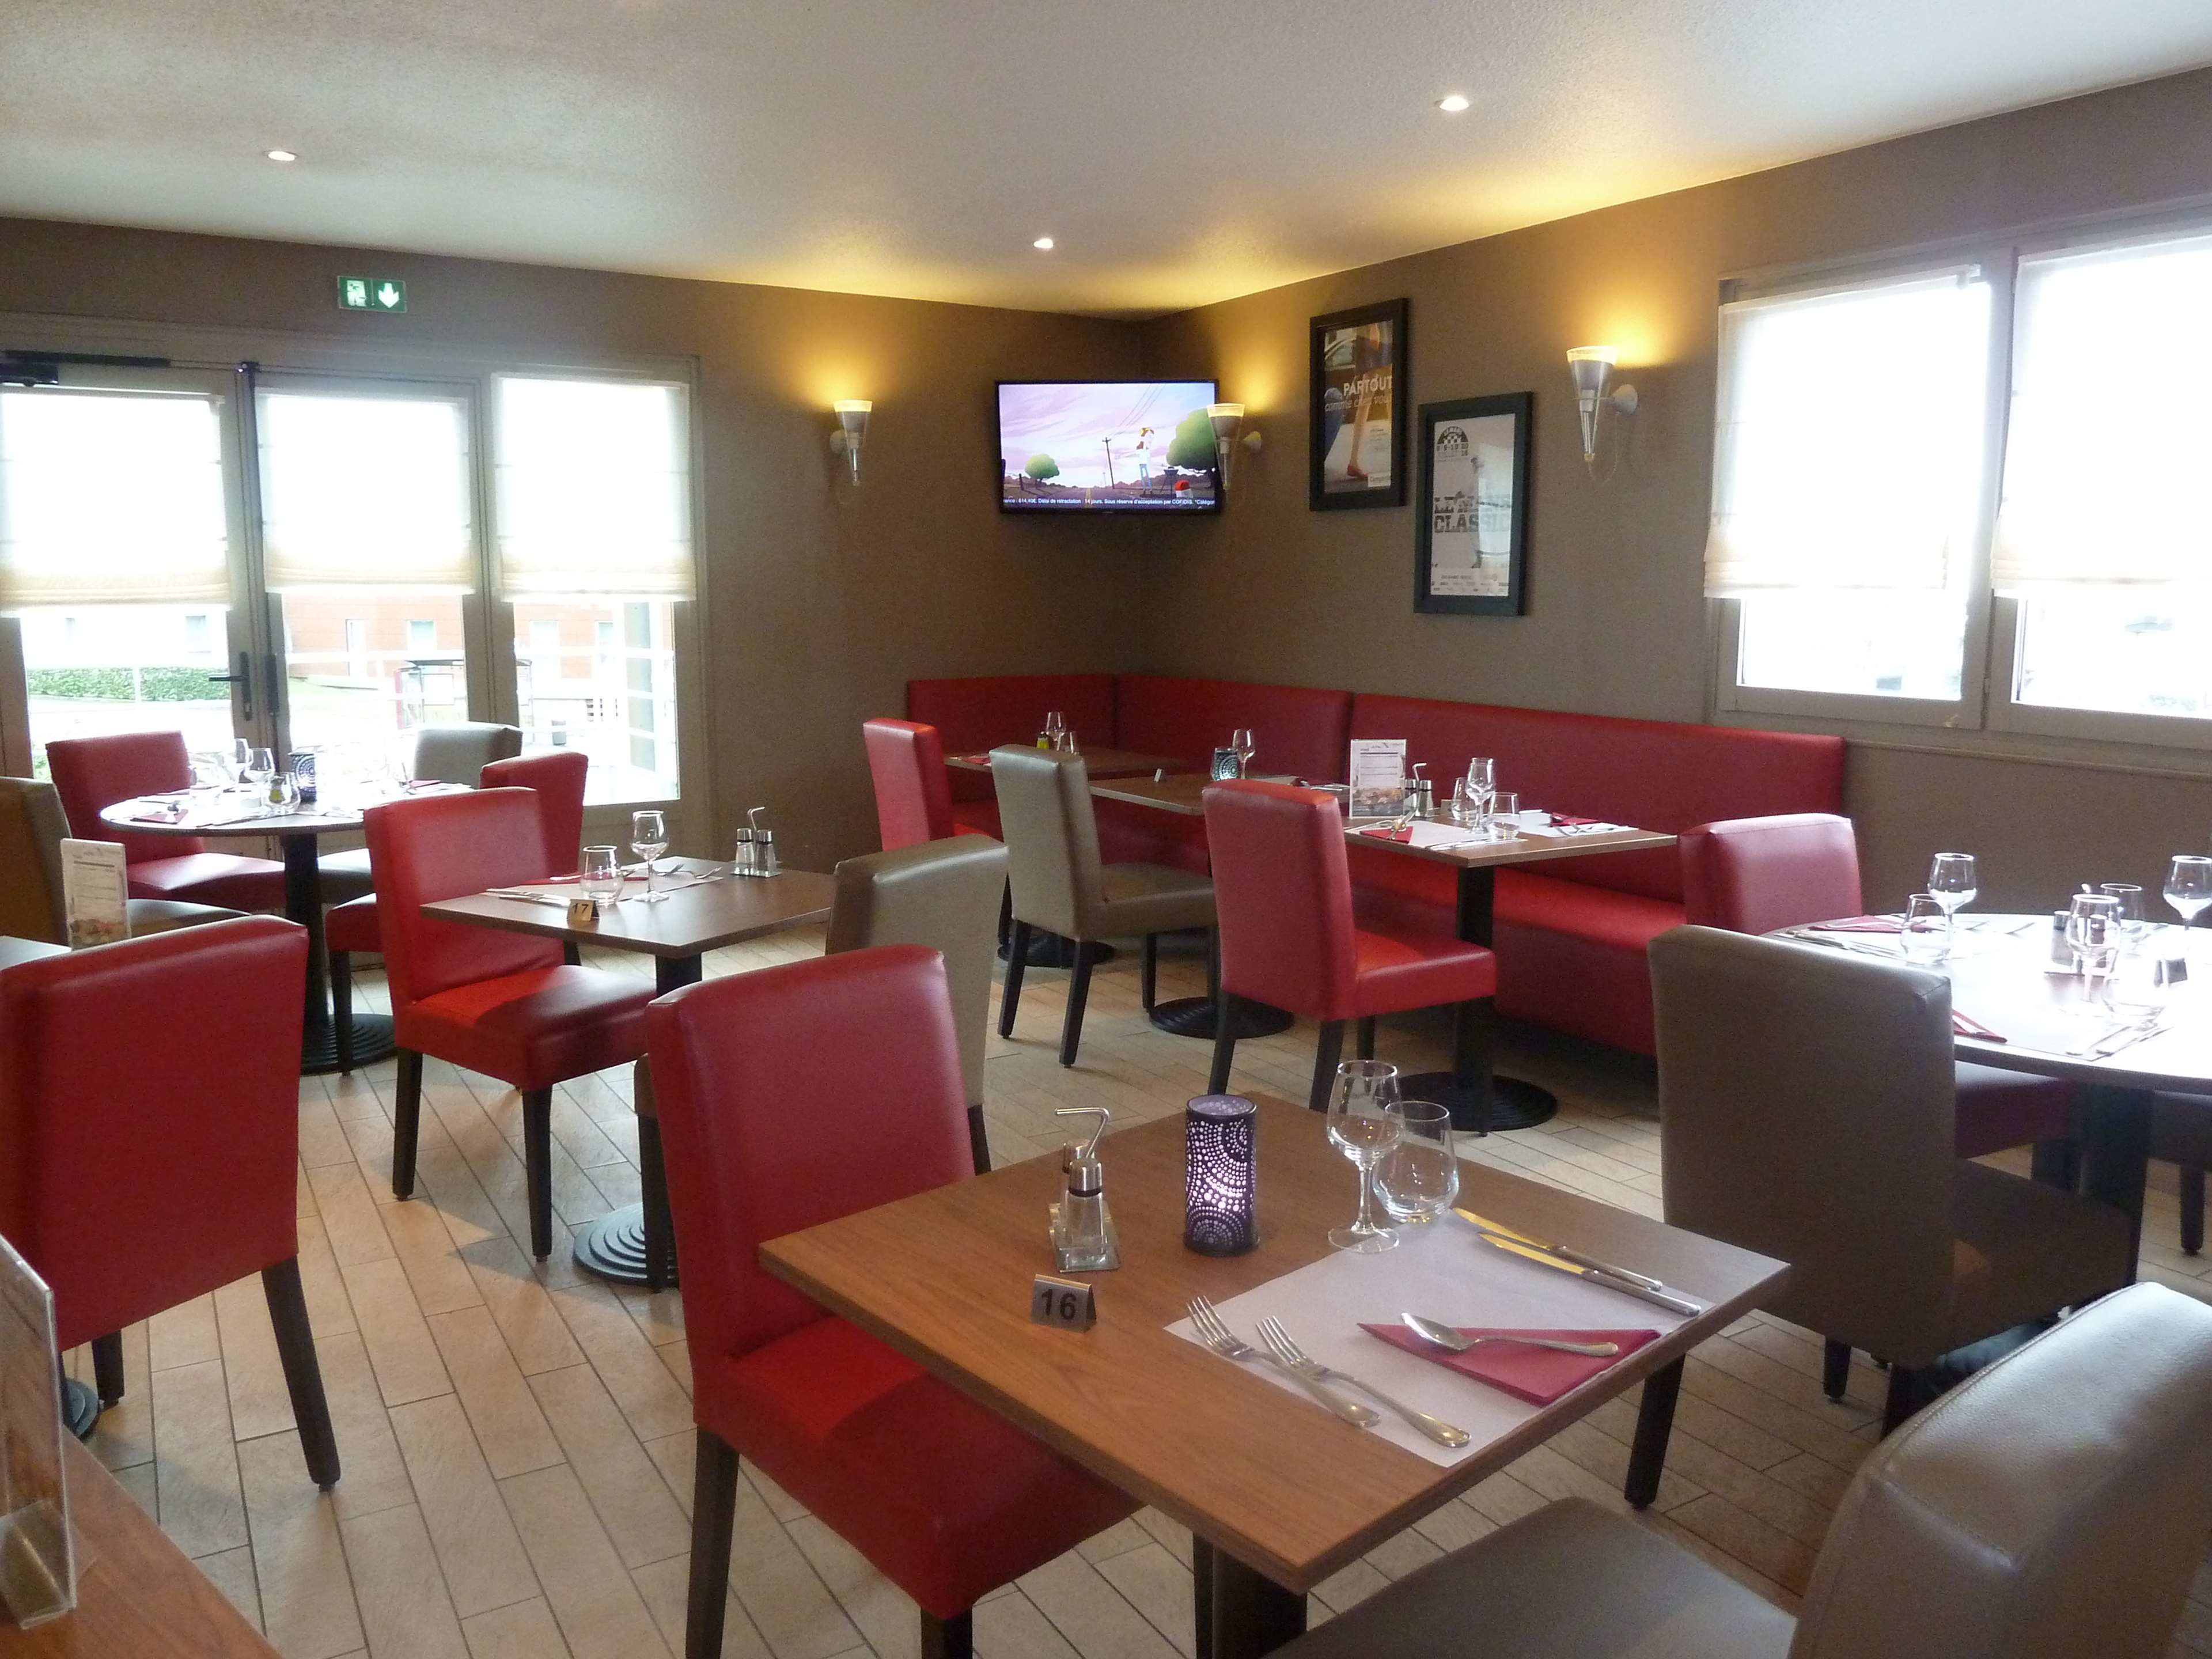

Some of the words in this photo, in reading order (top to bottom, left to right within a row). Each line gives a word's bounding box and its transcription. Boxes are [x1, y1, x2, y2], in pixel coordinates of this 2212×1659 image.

[1343, 376, 1392, 396] PARTOUT
[572, 903, 589, 914] 17
[1041, 1289, 1077, 1320] 16
